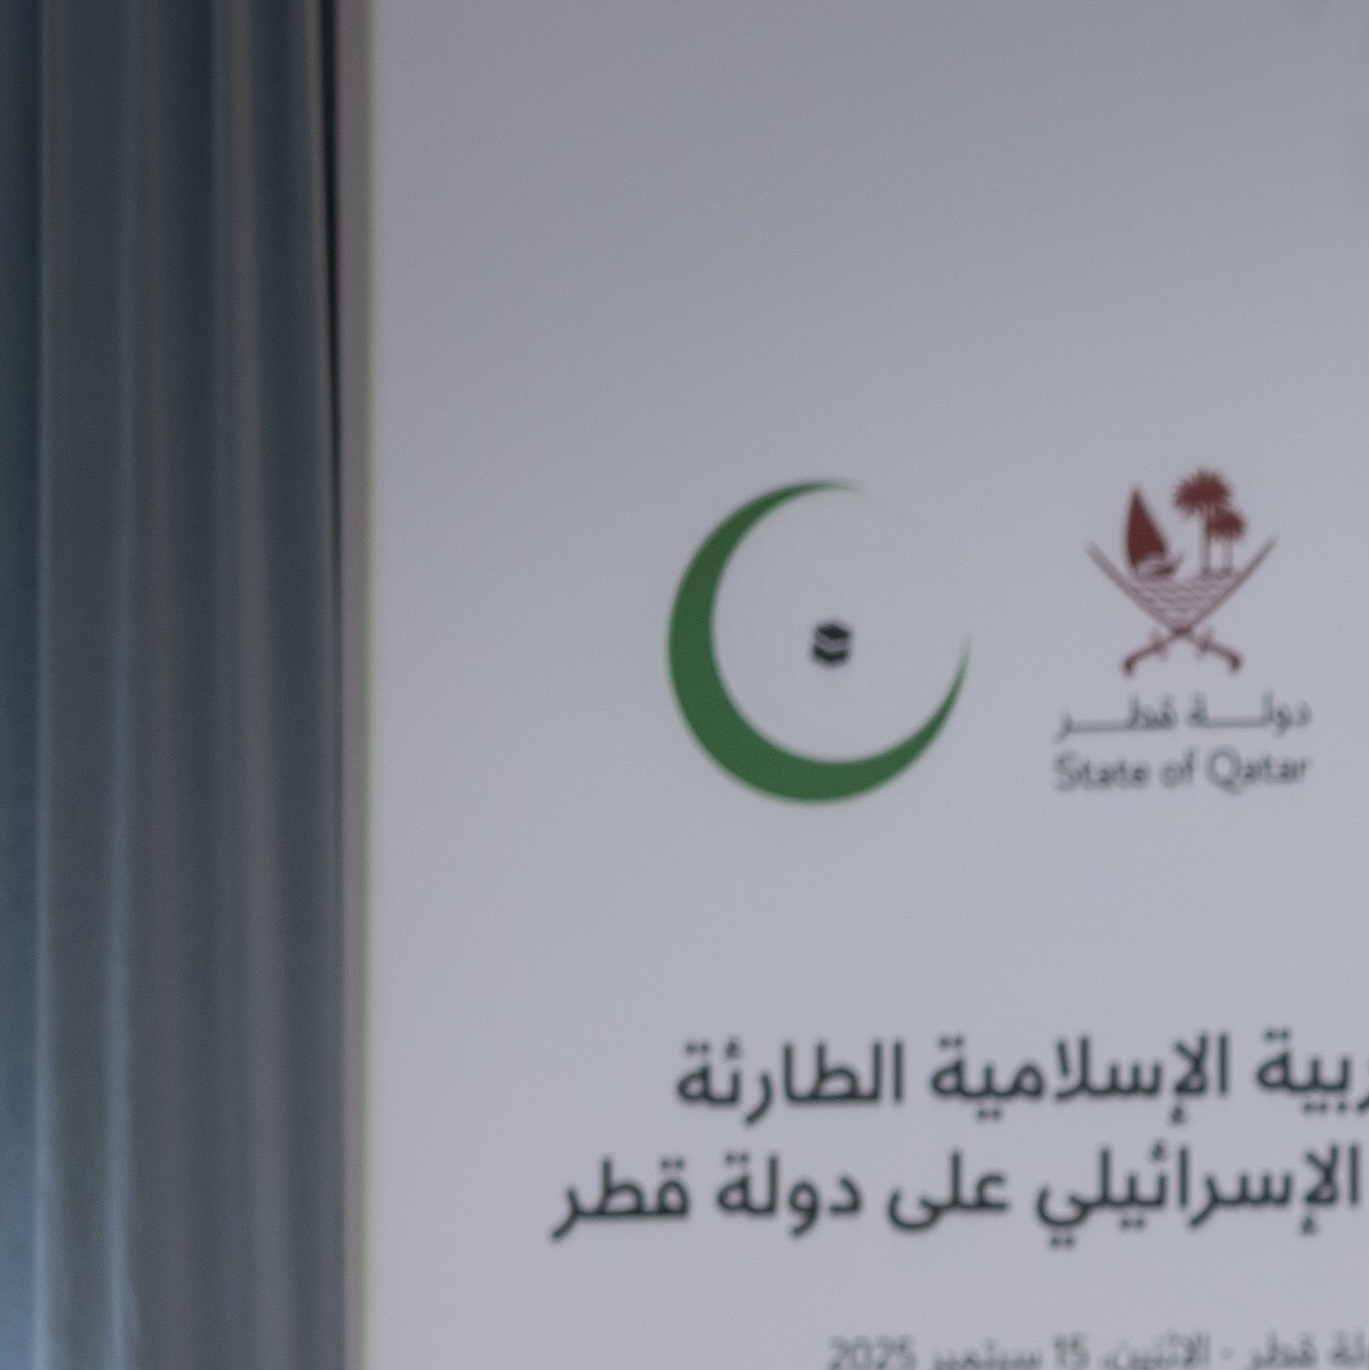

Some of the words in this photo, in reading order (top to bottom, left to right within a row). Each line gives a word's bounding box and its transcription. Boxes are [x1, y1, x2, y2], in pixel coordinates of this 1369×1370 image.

[1055, 752, 1150, 792] State
[1161, 750, 1196, 788] of
[1207, 750, 1308, 794] Qatar
[673, 1037, 907, 1128] الطارئة
[927, 1030, 1232, 1127] الإسلامية
[548, 1155, 693, 1245] قطر
[712, 1148, 866, 1241] دولة
[884, 1148, 1012, 1237] على
[1033, 1138, 1363, 1252] الإسرائيلي
